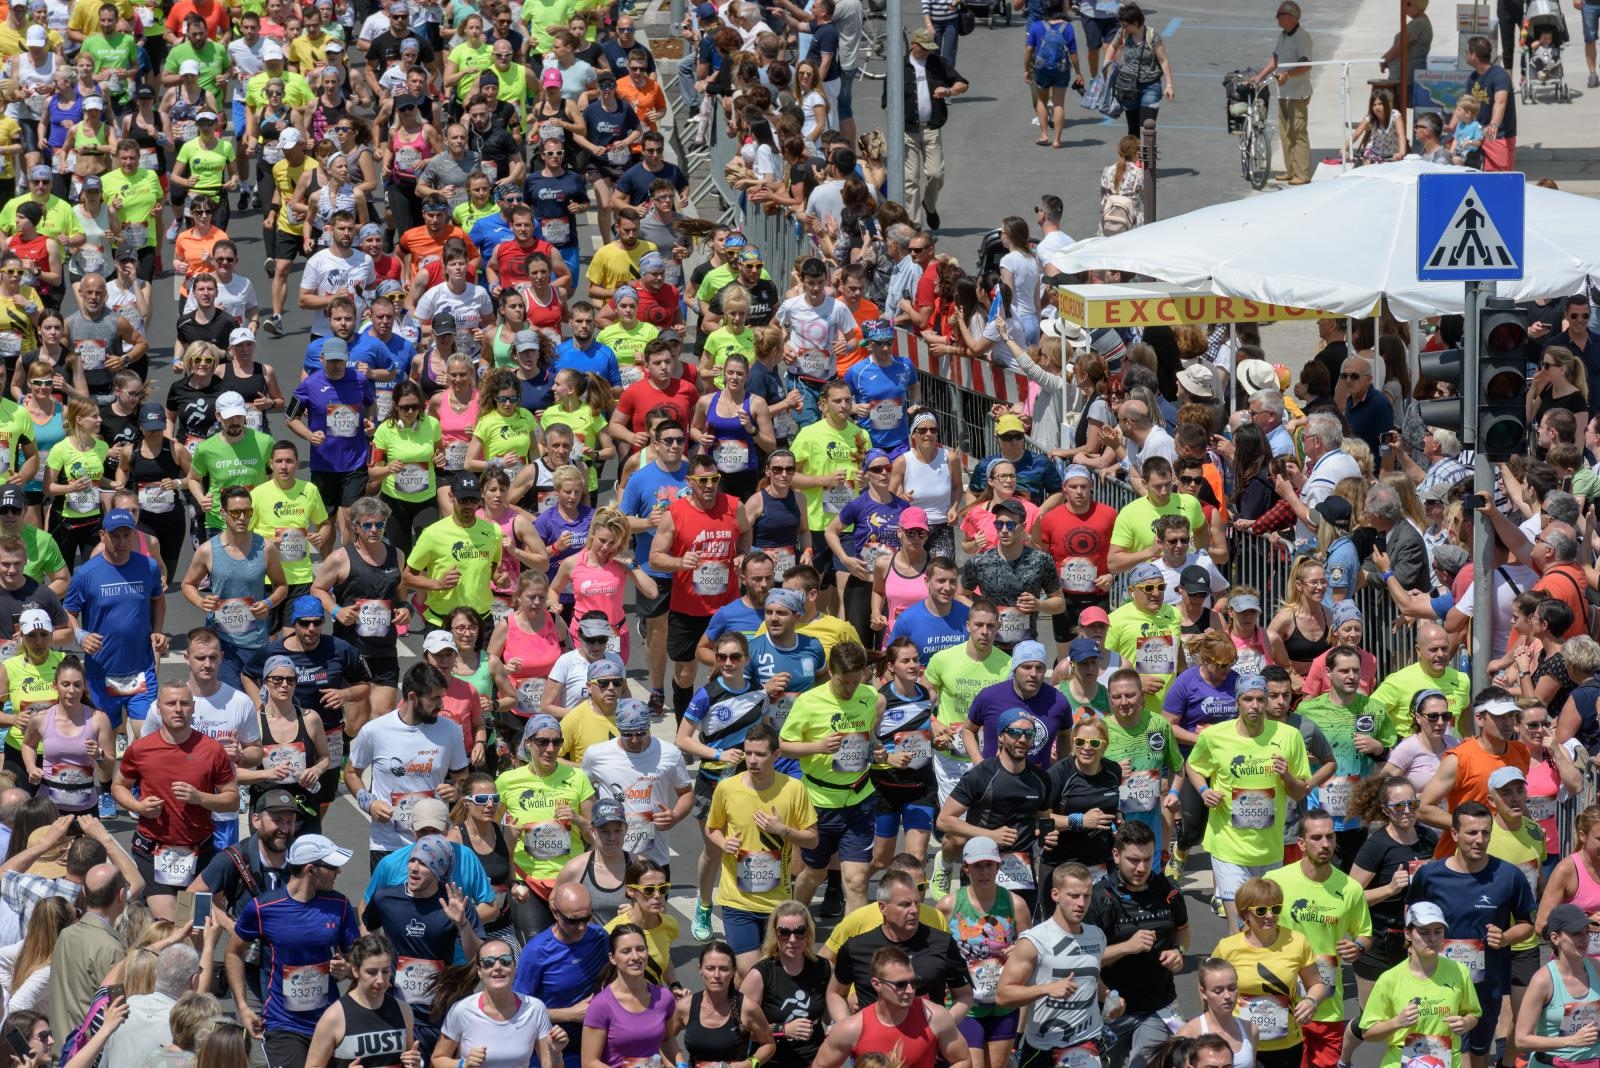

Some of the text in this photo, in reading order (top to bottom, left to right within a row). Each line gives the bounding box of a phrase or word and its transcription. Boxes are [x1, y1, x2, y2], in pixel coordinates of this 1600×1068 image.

[1105, 296, 1338, 324] EXCURSIO
[216, 457, 258, 469] OTP Group
[228, 469, 248, 478] TEAM
[400, 477, 424, 486] 63707
[1065, 573, 1092, 582] 21942
[222, 614, 249, 625] 35761
[360, 617, 387, 626] 35740
[927, 637, 934, 645] IF
[941, 634, 966, 643] DOESN'T
[1142, 654, 1169, 664] 44353
[840, 752, 866, 761] 26923
[1127, 790, 1154, 800] 41621
[1238, 807, 1270, 818] 35556
[533, 840, 563, 849] 19658
[161, 863, 192, 874] 21934
[743, 870, 775, 880] 25025
[998, 872, 1029, 883] 62302
[290, 985, 323, 998] 33279
[1250, 1016, 1277, 1028] 6994
[354, 1030, 403, 1058] JUST
